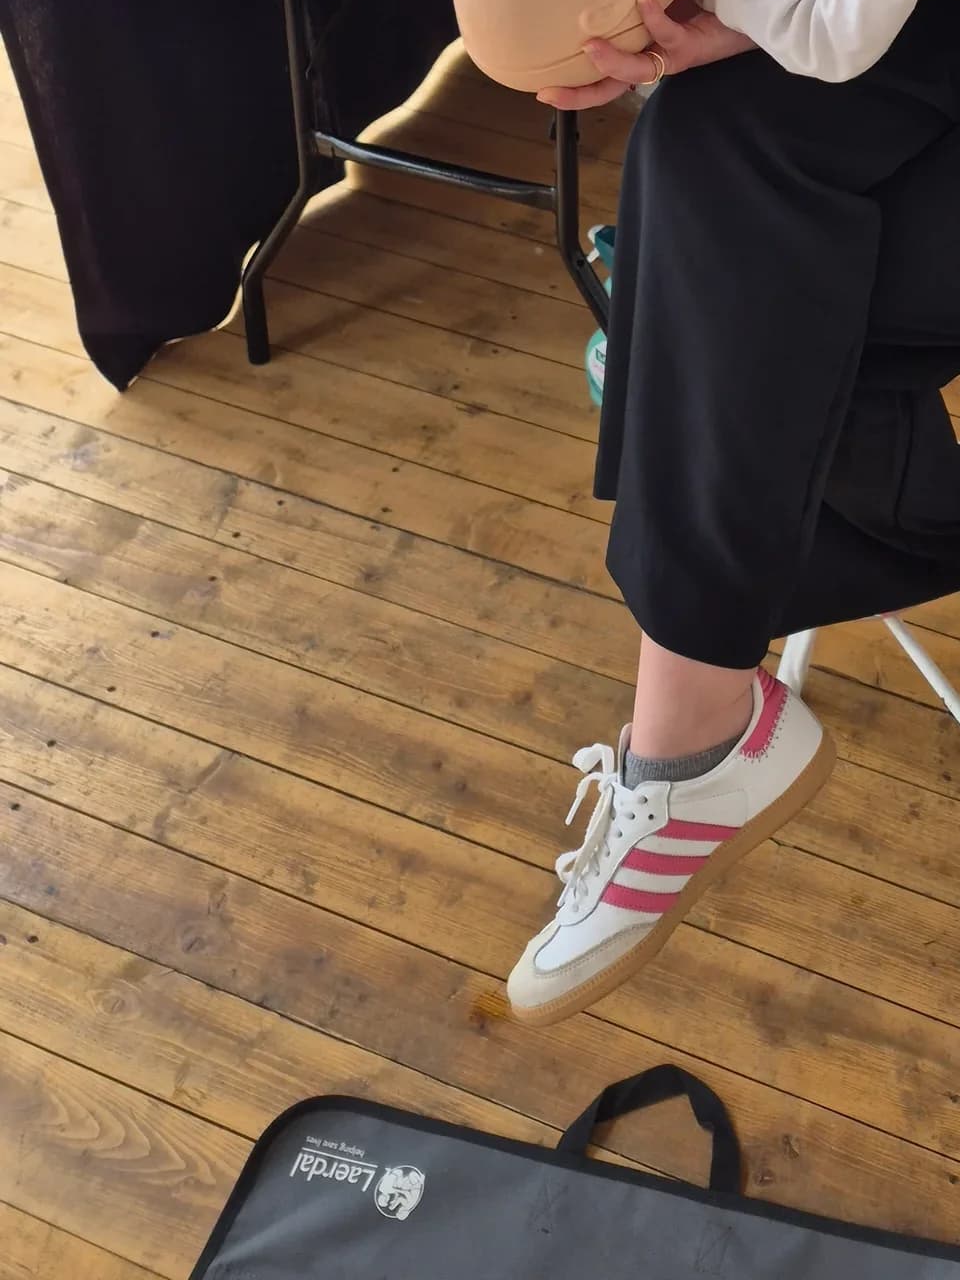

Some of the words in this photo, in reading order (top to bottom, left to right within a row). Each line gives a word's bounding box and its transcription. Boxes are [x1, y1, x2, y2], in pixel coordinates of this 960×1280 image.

[306, 1136, 321, 1147] lives
[322, 1140, 338, 1150] save
[339, 1142, 365, 1158] helping
[290, 1153, 376, 1192] Laerdal
